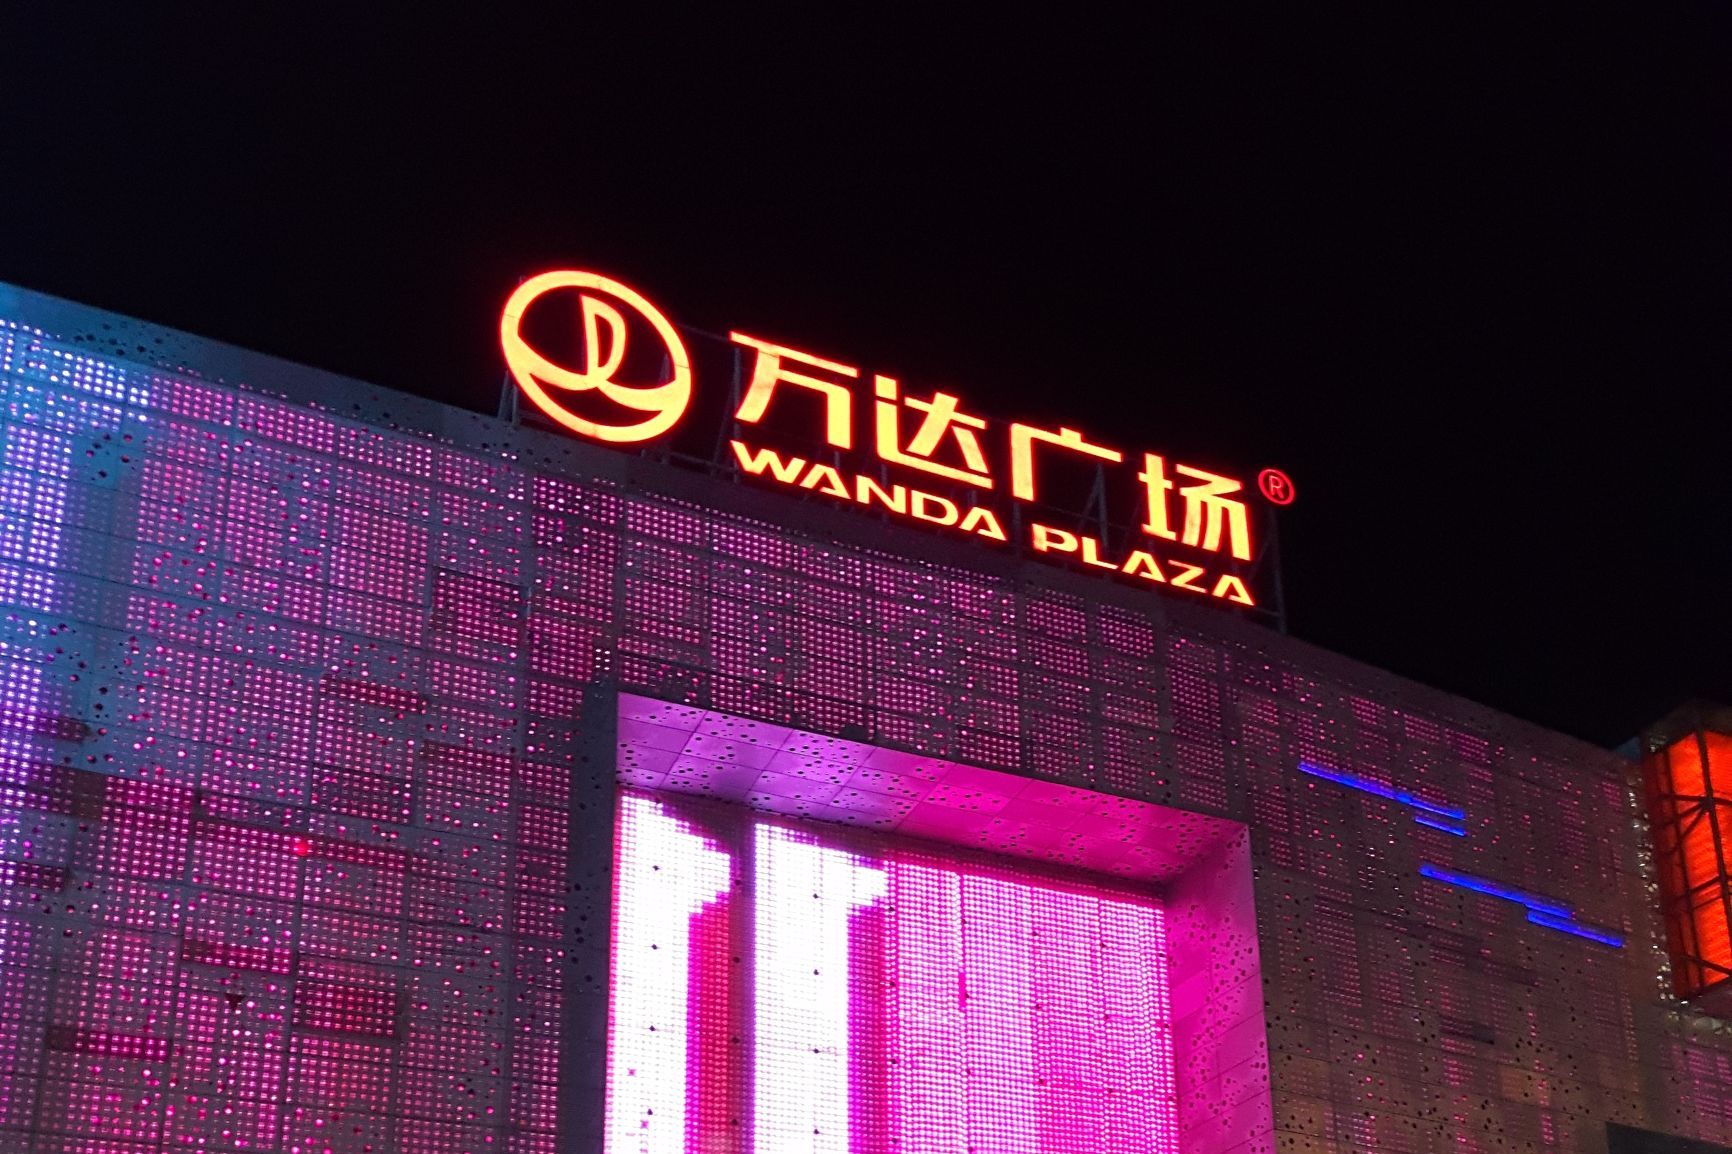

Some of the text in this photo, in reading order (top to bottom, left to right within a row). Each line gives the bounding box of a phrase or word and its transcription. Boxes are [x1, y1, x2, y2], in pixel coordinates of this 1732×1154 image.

[730, 330, 1251, 561] 万达广场
[730, 439, 1256, 606] WANDA PLAZA
